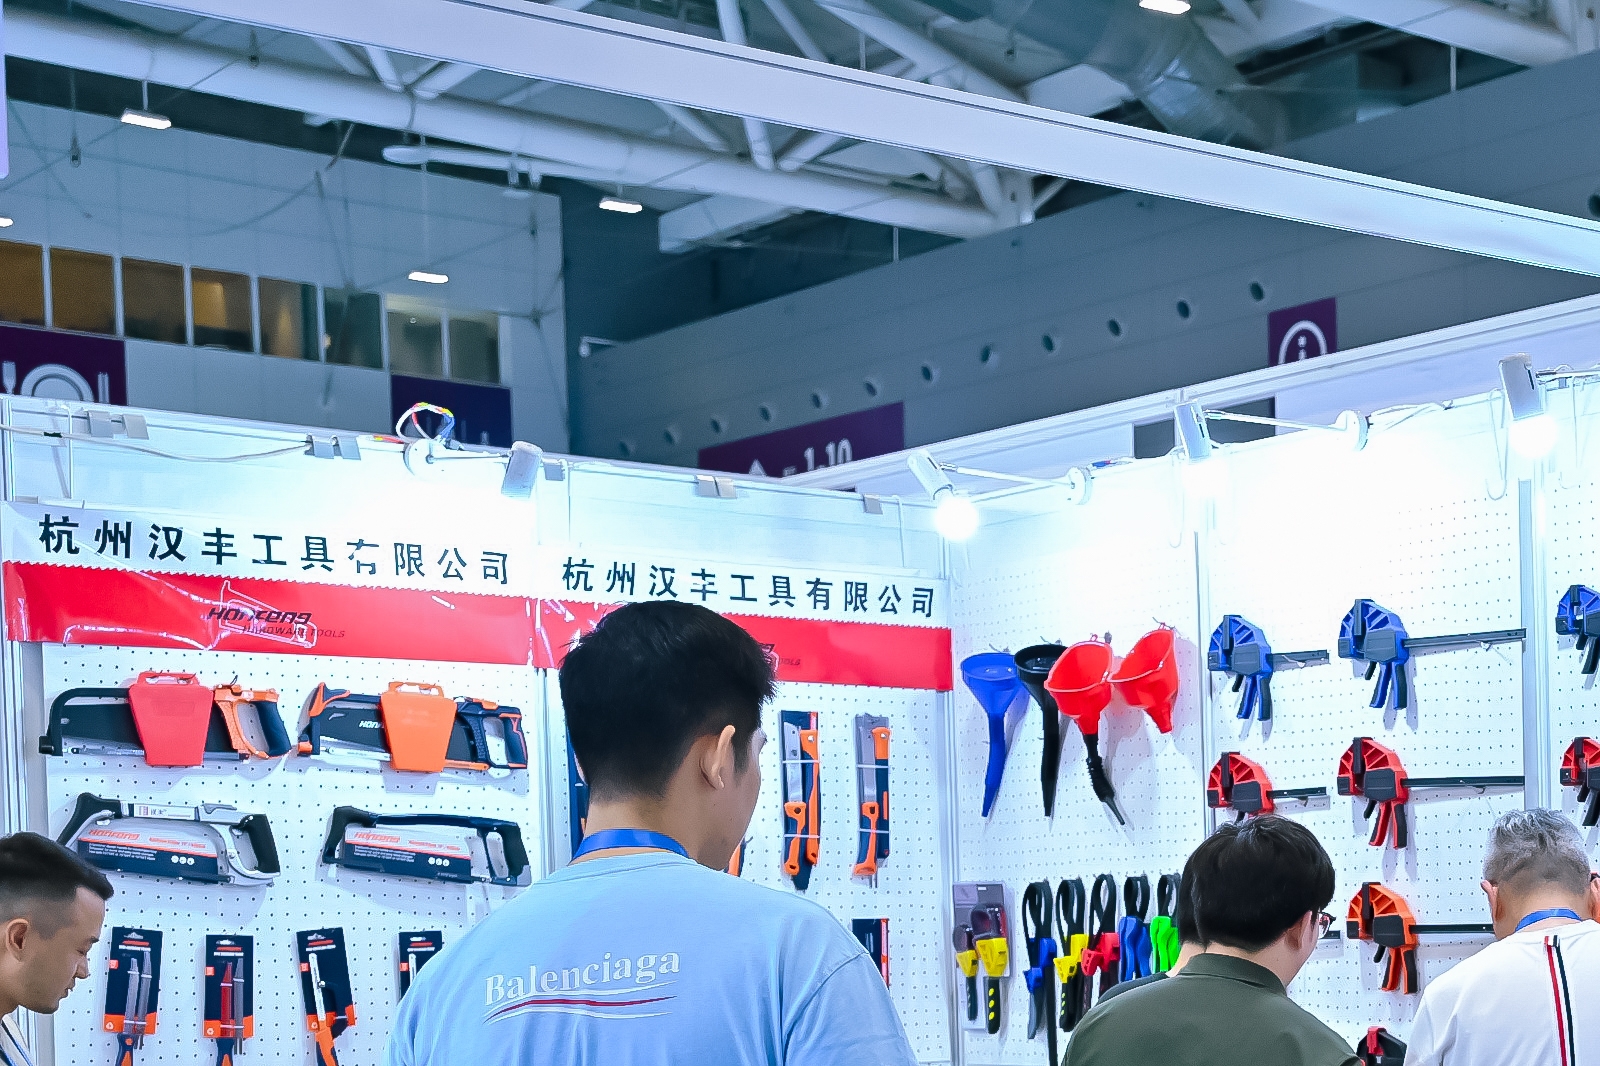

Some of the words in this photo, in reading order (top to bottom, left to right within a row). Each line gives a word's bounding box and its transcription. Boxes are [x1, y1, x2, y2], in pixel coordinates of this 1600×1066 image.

[38, 512, 509, 585] 杭州汉丰工具有限公司
[562, 556, 935, 618] 杭州汉丰工具有限公司
[484, 951, 681, 1006] Balenciaga
